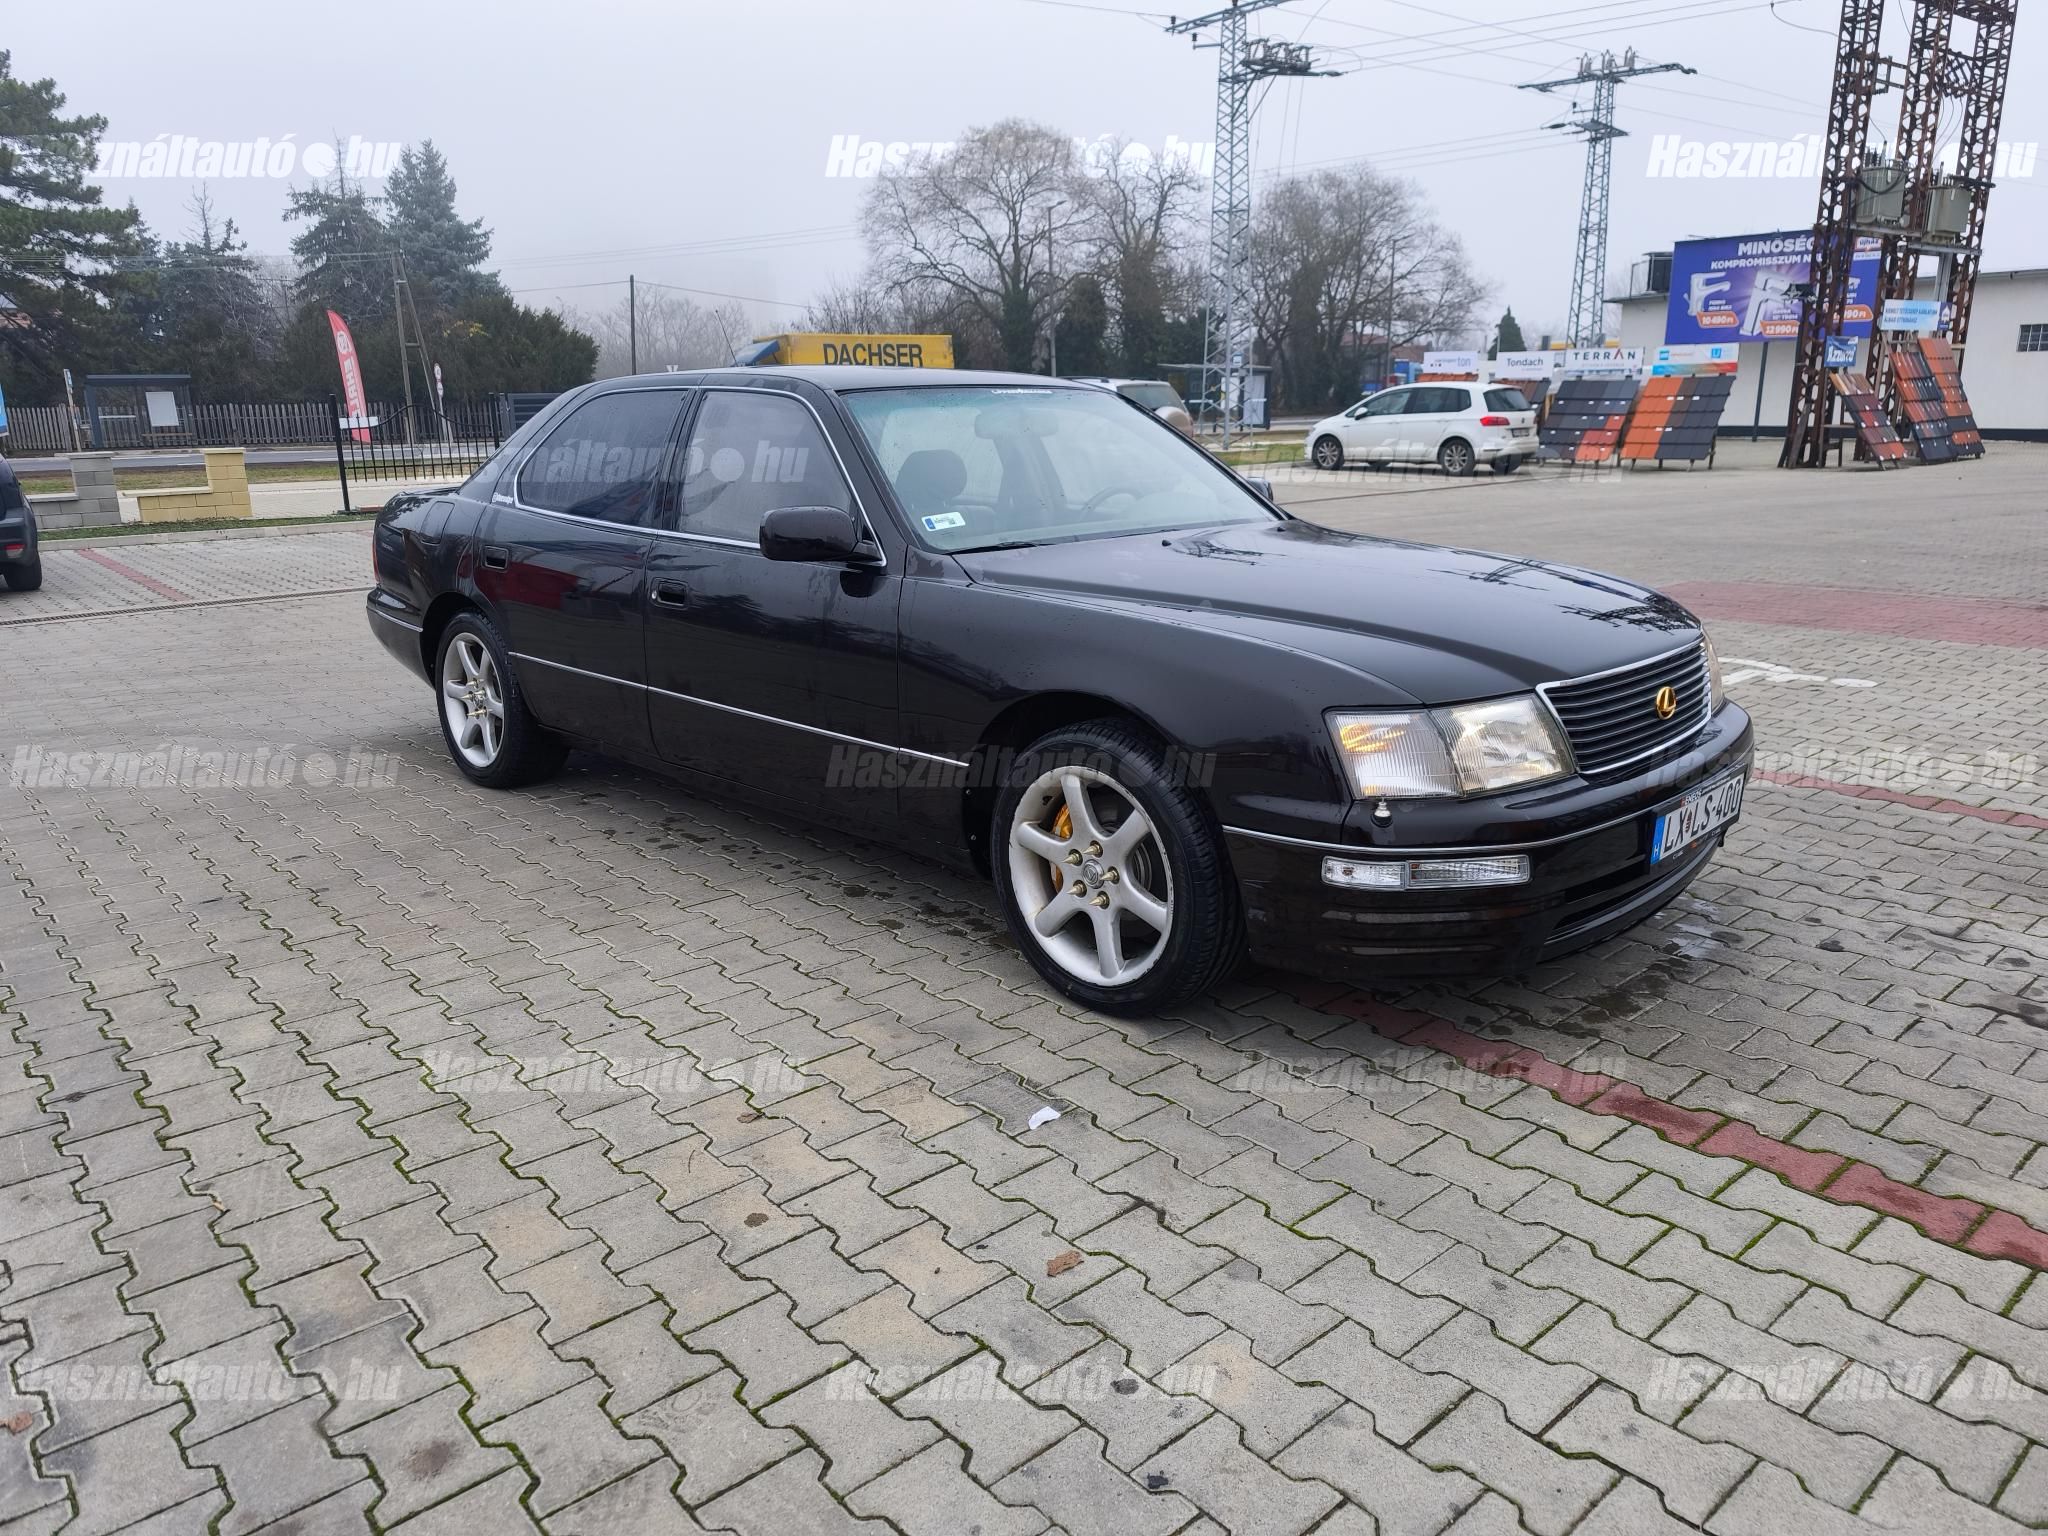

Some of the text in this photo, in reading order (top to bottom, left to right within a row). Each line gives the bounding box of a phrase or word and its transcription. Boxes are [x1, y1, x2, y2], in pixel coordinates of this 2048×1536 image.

[1711, 255, 1801, 270] KOMPROMISSZUM
[823, 343, 924, 368] DACHSER
[1507, 358, 1543, 367] Tondach
[1664, 778, 1741, 853] LX LS-400
